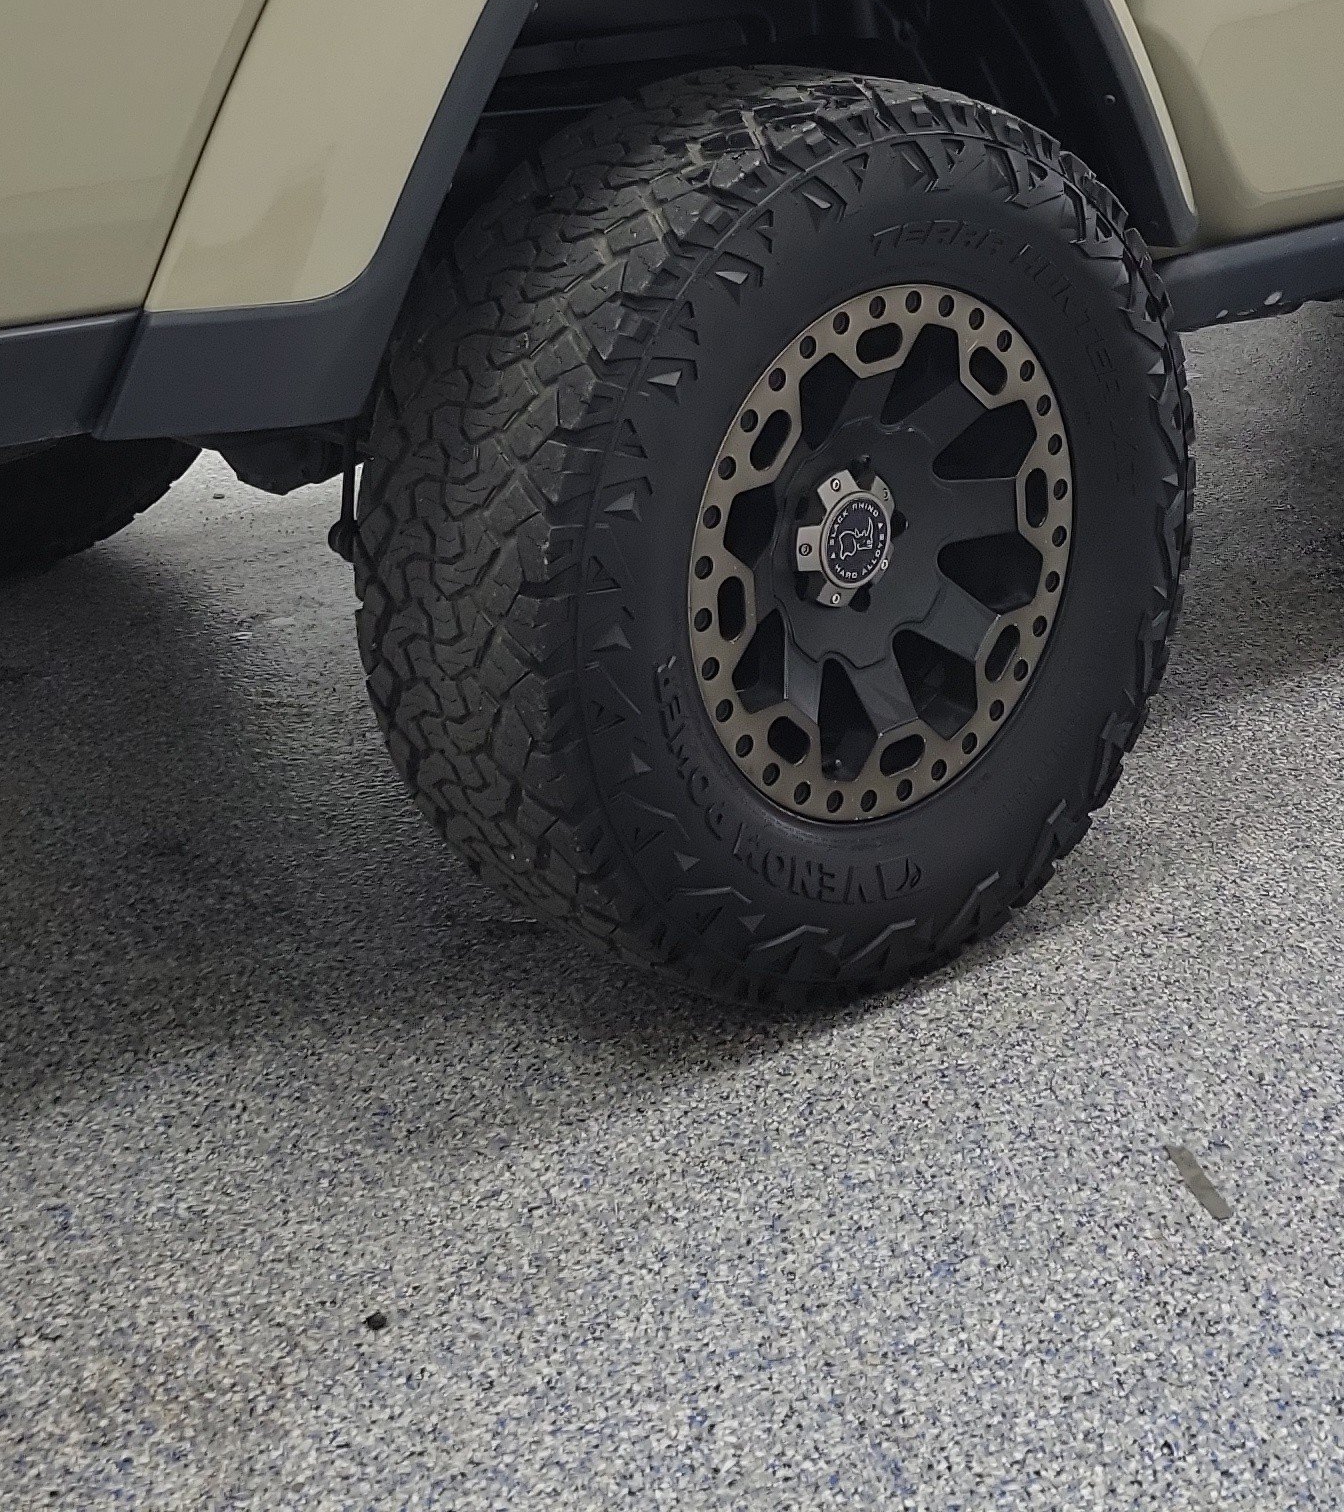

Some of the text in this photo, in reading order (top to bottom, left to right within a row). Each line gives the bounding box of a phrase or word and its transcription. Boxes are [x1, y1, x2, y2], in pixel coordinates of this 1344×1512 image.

[829, 503, 879, 546] BLACK RHINO
[835, 564, 858, 579] HARD
